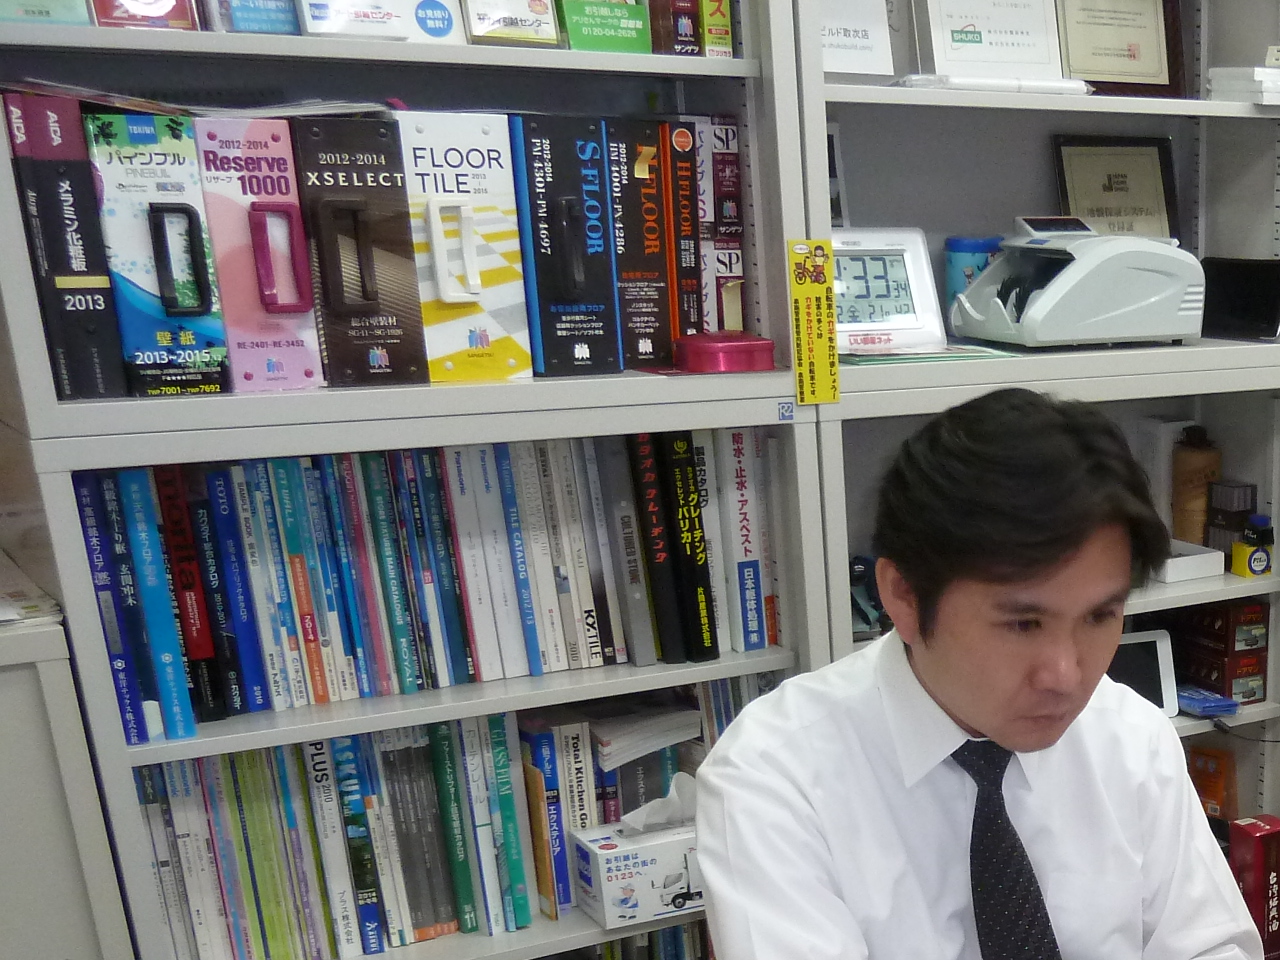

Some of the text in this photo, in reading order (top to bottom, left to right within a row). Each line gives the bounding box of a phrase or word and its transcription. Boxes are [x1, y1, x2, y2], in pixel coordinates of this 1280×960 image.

[10, 105, 27, 145] AIDA
[47, 110, 63, 147] AIDA
[218, 139, 269, 150] 2012-2014
[713, 126, 737, 151] SP
[106, 150, 186, 167] パインブル
[203, 150, 289, 173] Reserve
[318, 153, 386, 165] 2012-2014
[413, 147, 505, 169] FLOOR
[237, 175, 291, 196] 1000
[306, 172, 405, 187] XSELECT
[415, 172, 471, 194] TILE
[716, 250, 740, 276] SP
[64, 295, 106, 311] 2013
[215, 477, 230, 515] TOTO
[688, 492, 707, 566] グレーチング
[509, 507, 527, 579] TILE CATALOG
[1240, 613, 1264, 623] ドアマン
[1236, 664, 1259, 674] ドアマン
[253, 685, 264, 705] 2010
[571, 733, 582, 770] Total
[309, 741, 334, 803] PLUS 2010
[575, 769, 587, 809] Kitchen
[605, 853, 640, 866] お引越は
[605, 858, 658, 875] あなたの街の
